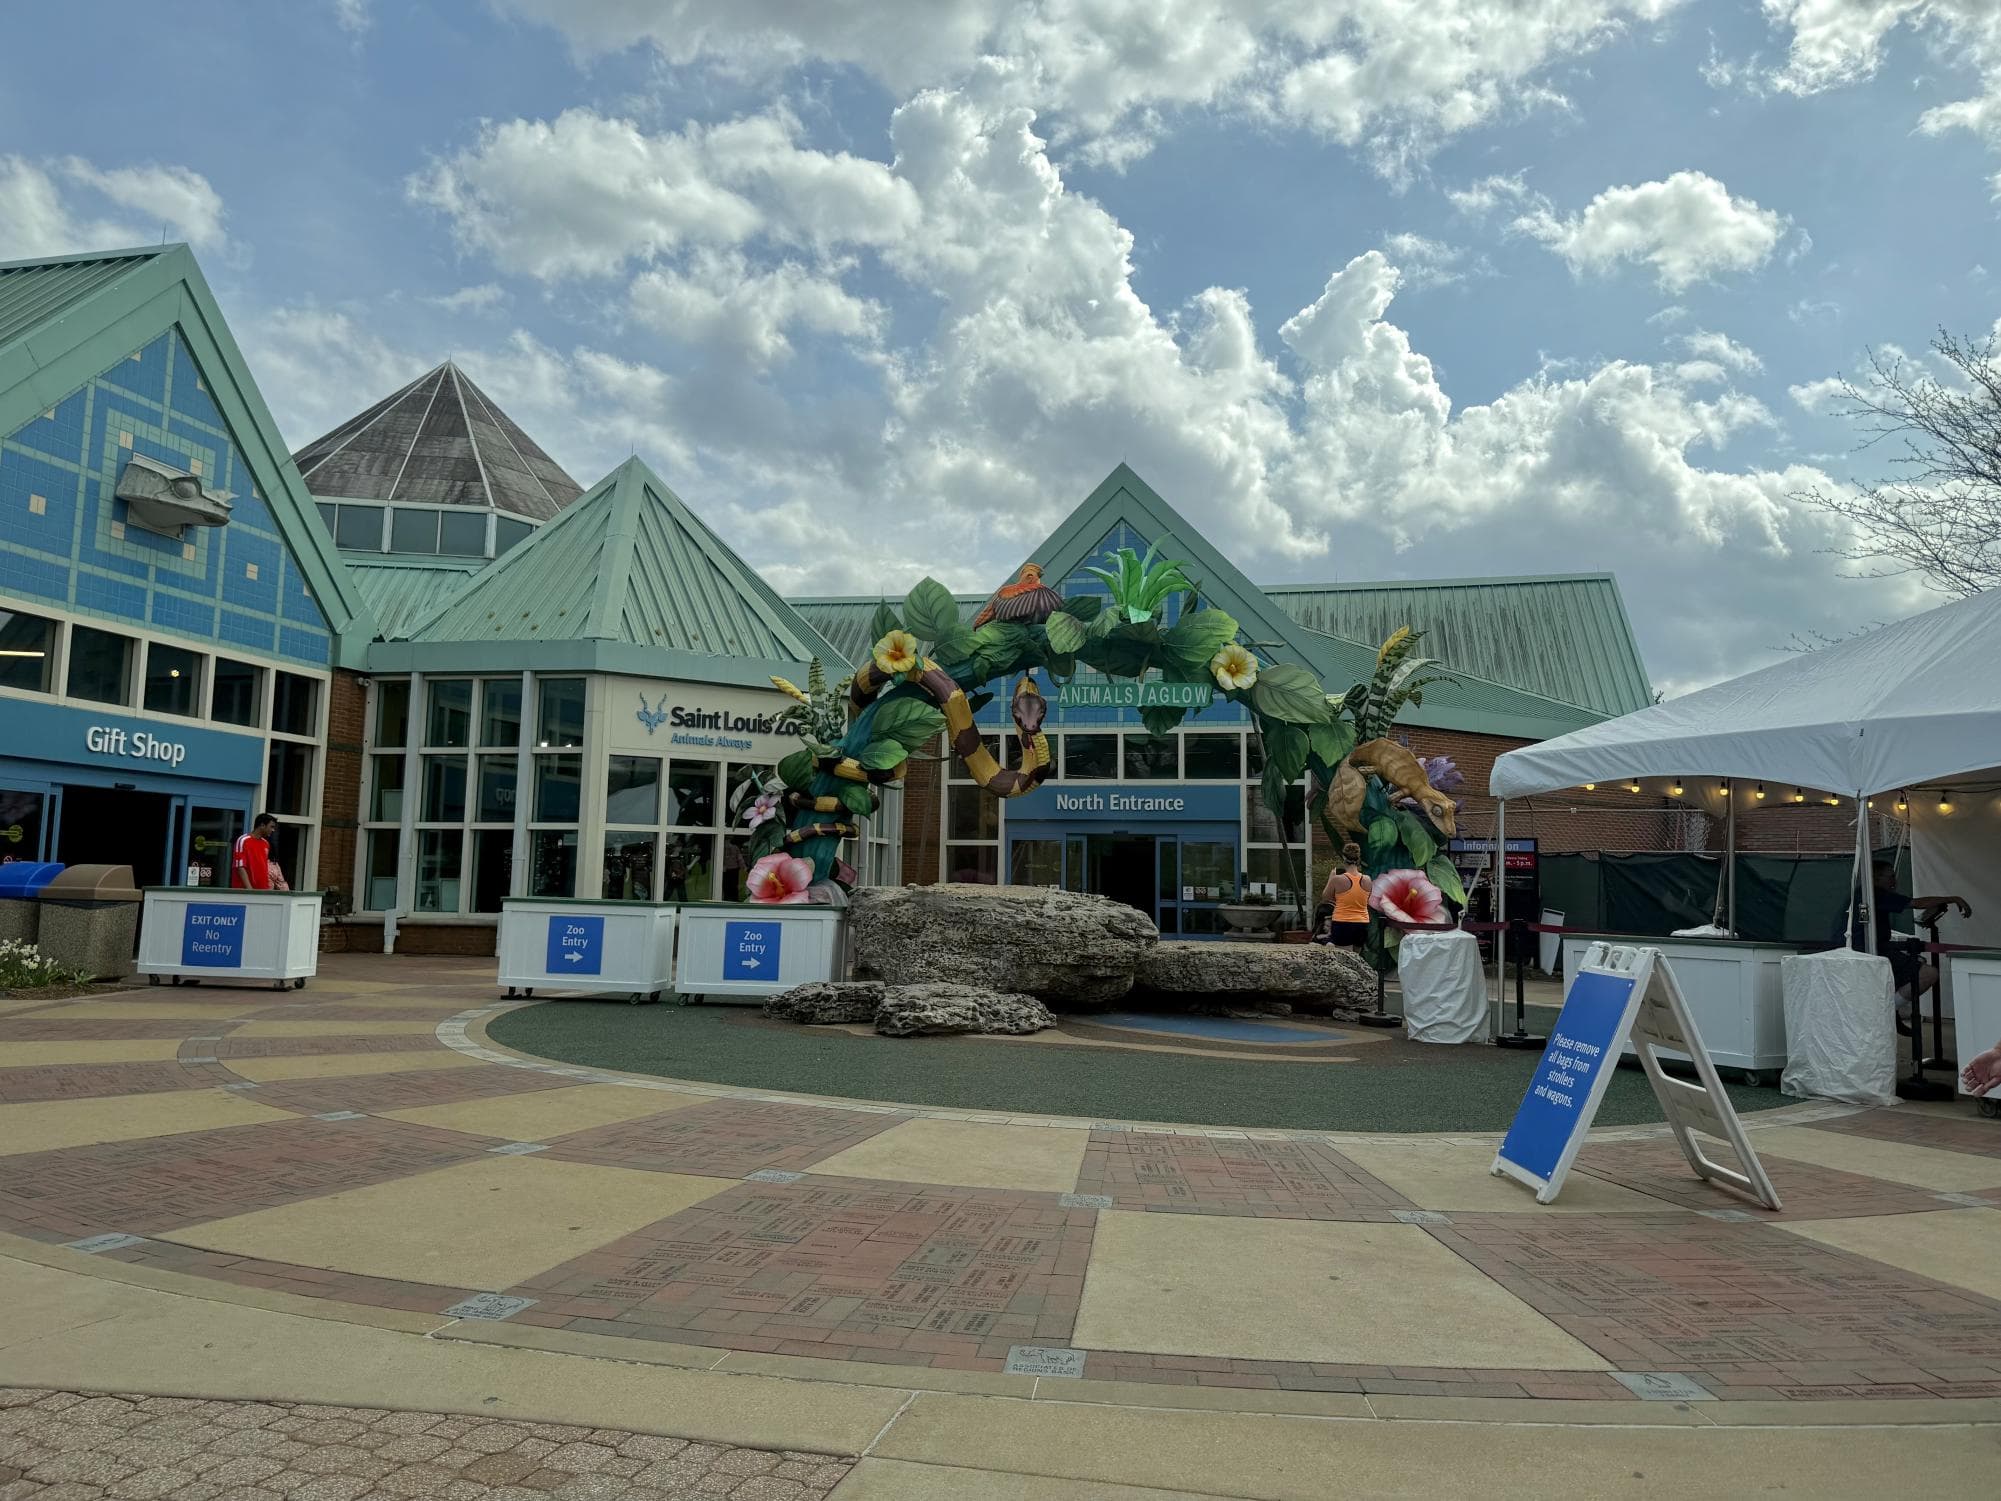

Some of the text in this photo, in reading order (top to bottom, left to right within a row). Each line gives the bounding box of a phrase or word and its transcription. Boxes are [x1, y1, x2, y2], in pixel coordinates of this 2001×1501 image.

[1059, 686, 1208, 704] ANIMALS AGLOW
[670, 706, 721, 730] Saint
[723, 711, 773, 734] Louis
[86, 726, 185, 767] Gift Shop
[671, 732, 753, 750] Animals Always
[1056, 793, 1184, 811] North Entrance
[1463, 839, 1519, 851] Informon
[191, 915, 238, 926] EXIT ONLY
[566, 924, 585, 935] Zoo
[205, 929, 220, 940] No
[562, 936, 588, 949] Entry
[743, 930, 763, 941] Zoo
[192, 941, 232, 956] Reentry
[739, 942, 766, 955] Entry
[1553, 1033, 1600, 1057] Please remove
[1548, 1050, 1590, 1074] all bags from
[1547, 1070, 1575, 1088] strollers
[1534, 1084, 1573, 1107] and wagons.
